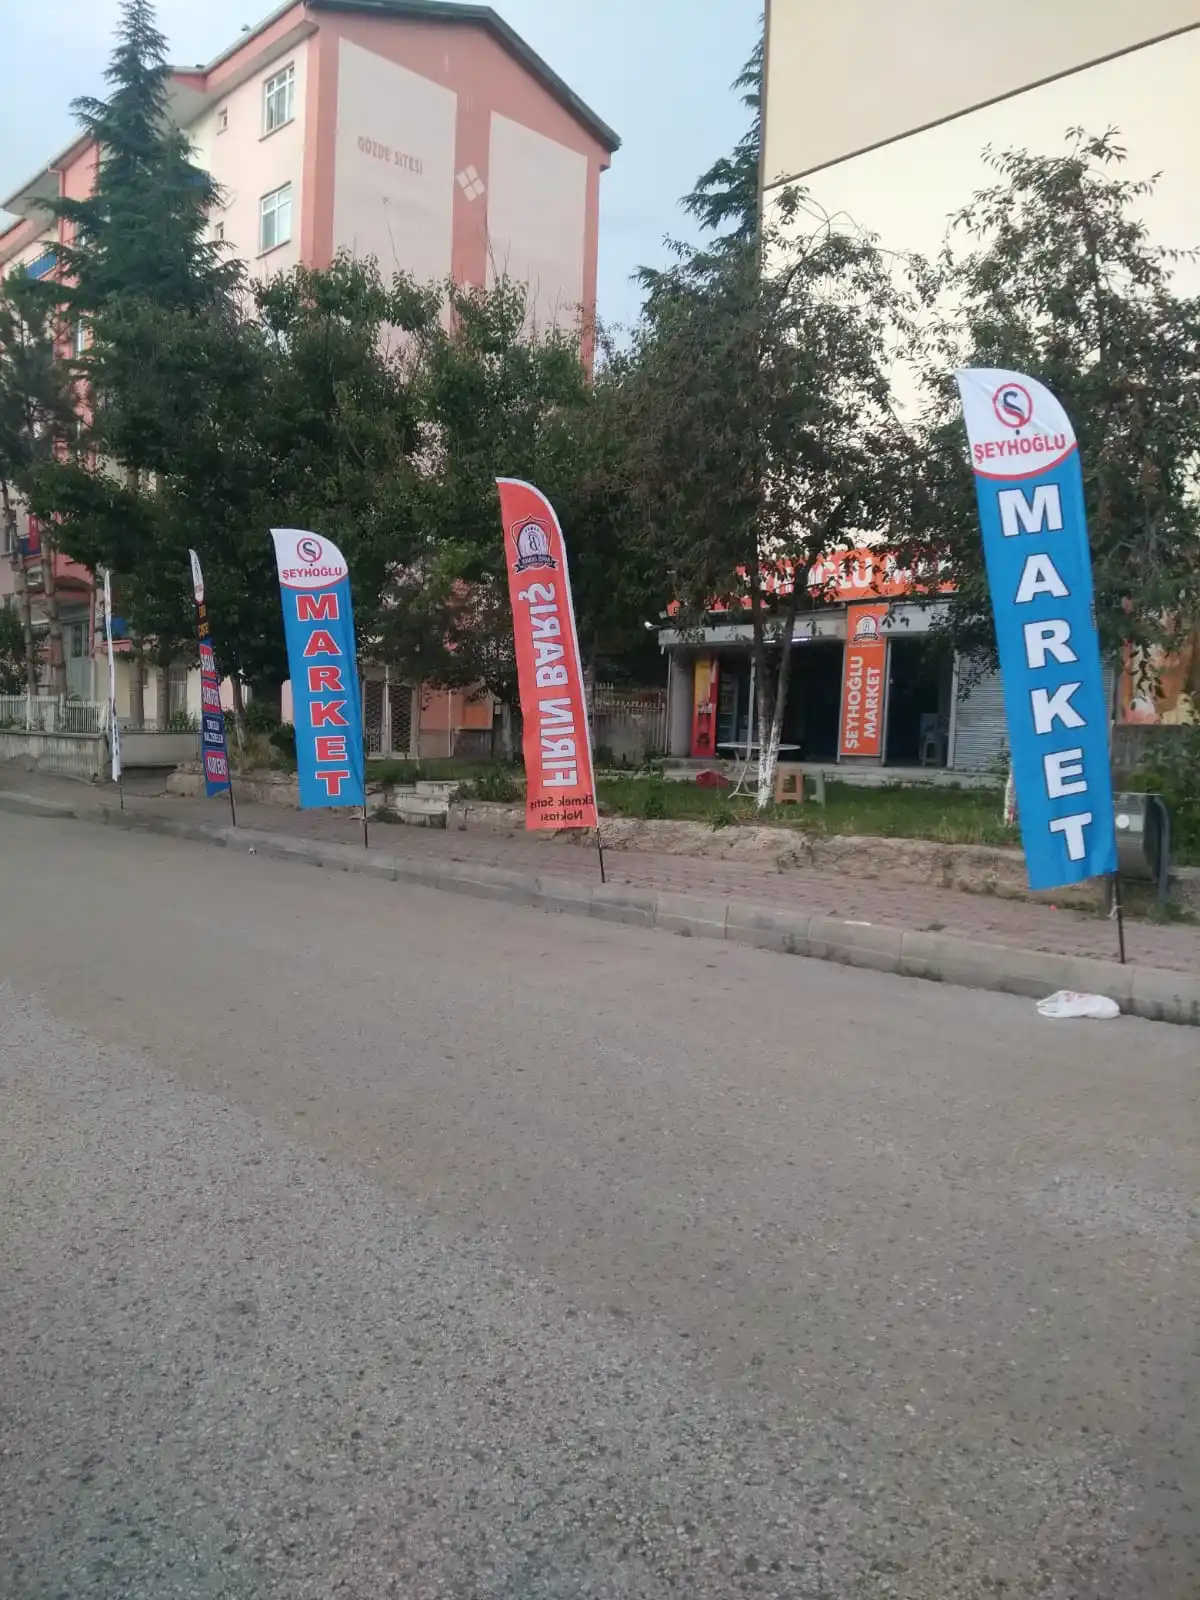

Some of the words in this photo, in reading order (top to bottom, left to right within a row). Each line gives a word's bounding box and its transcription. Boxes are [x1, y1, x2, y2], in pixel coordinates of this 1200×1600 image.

[973, 433, 1067, 465] ŞEYHOĞLU
[282, 566, 342, 580] ŞEYHOĞLU
[295, 592, 351, 796] MARKET
[845, 655, 864, 749] ŞEYHOĞLU
[863, 667, 881, 739] MARKET
[997, 483, 1093, 862] MARKET
